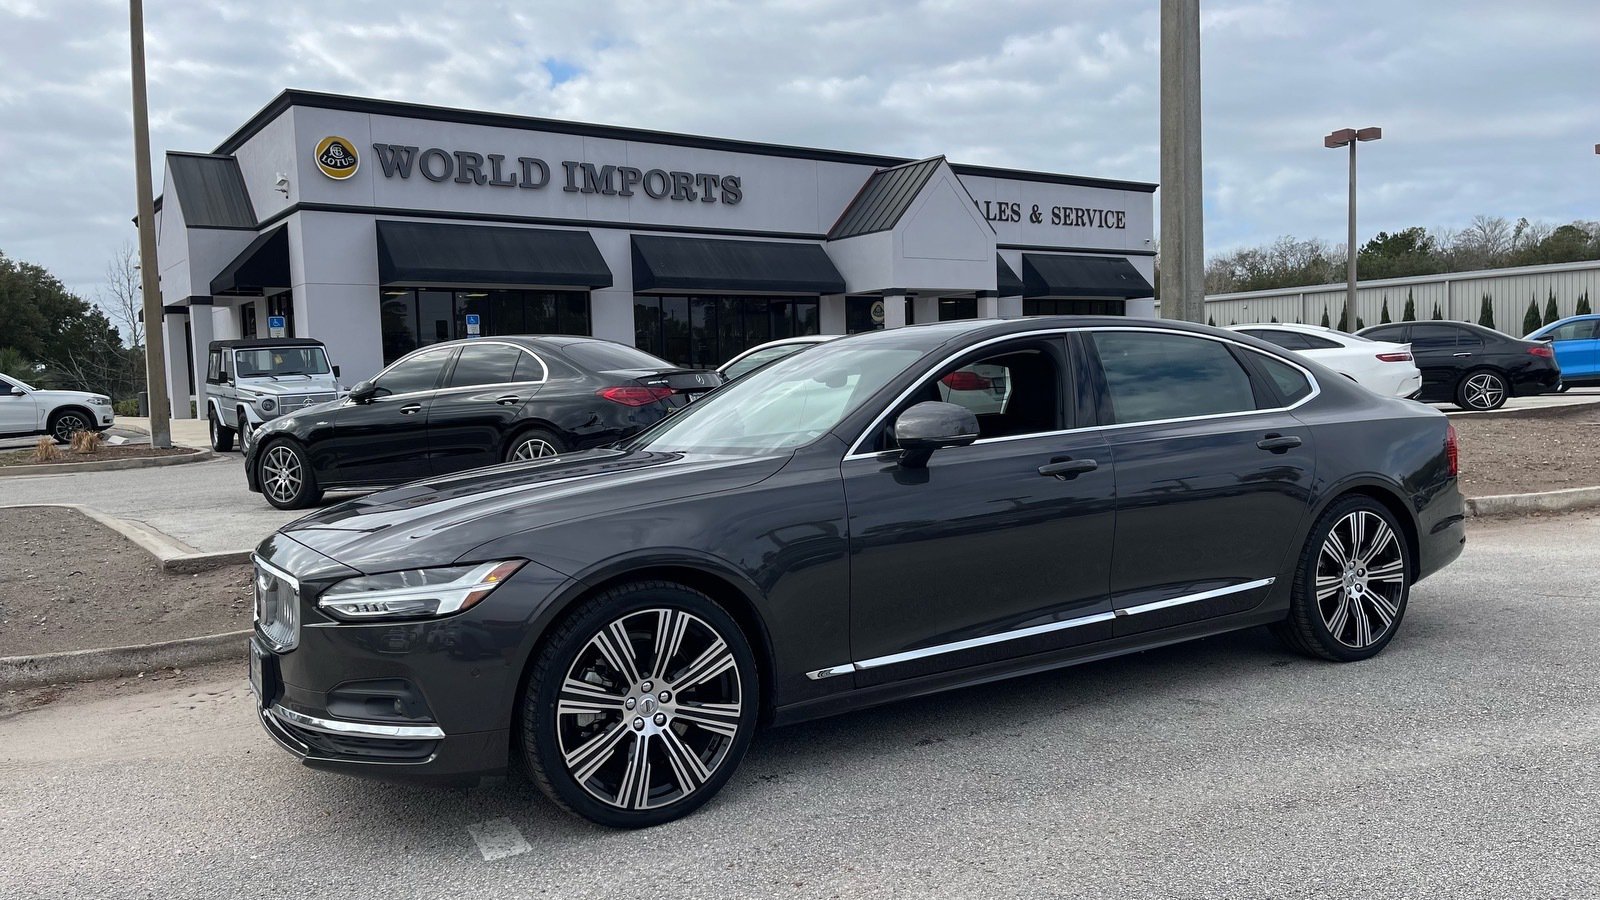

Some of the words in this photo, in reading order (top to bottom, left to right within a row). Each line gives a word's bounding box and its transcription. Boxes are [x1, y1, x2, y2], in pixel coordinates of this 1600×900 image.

[321, 155, 354, 166] LOTUS
[373, 143, 551, 189] WORLD
[562, 161, 743, 205] IMPORTS
[1029, 204, 1043, 224] &
[1051, 206, 1126, 229] SERVICE
